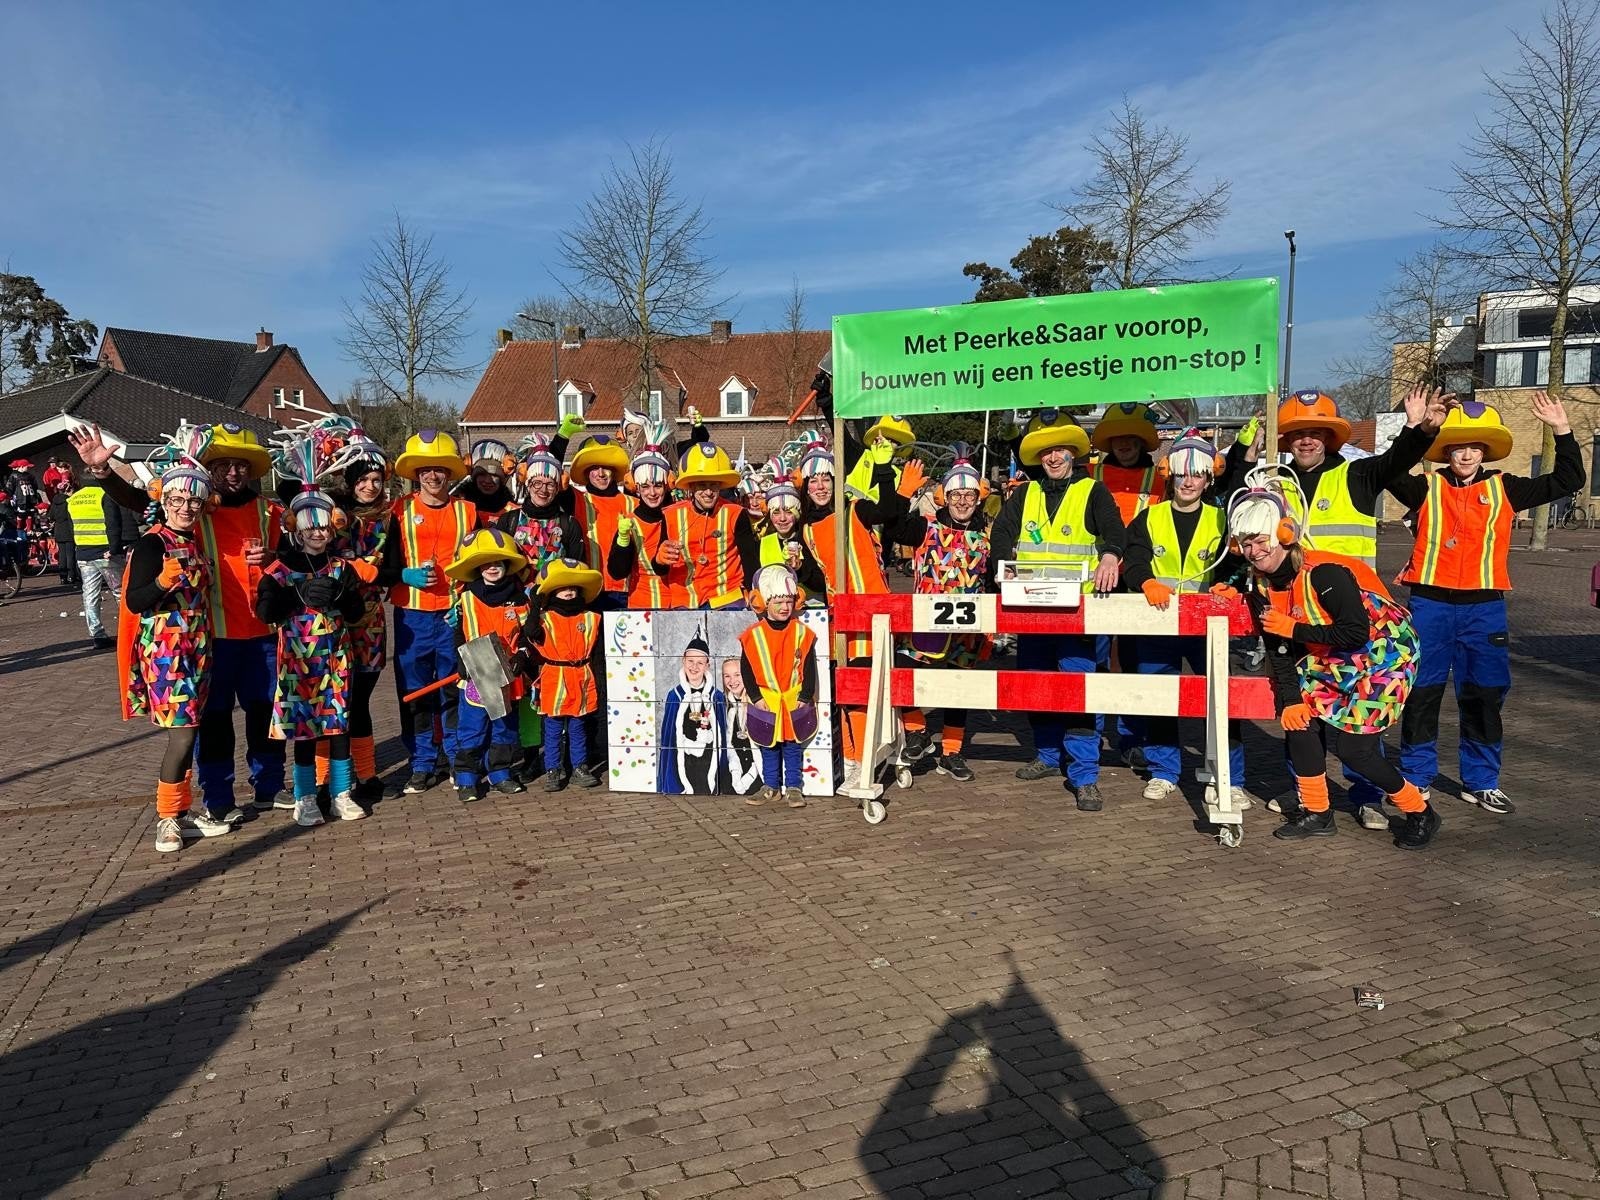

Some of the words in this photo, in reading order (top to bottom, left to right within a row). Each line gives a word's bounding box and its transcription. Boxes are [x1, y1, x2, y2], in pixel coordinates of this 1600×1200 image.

[905, 335, 948, 354] Met
[955, 322, 1107, 352] Peerke&Saar
[1115, 316, 1209, 339] voorop,
[860, 371, 946, 390] bouwen
[954, 364, 984, 389] wij
[992, 366, 1033, 383] een
[1041, 355, 1124, 381] feestje
[1132, 348, 1246, 373] non-stop
[1256, 343, 1261, 364] !
[934, 602, 976, 625] 23
